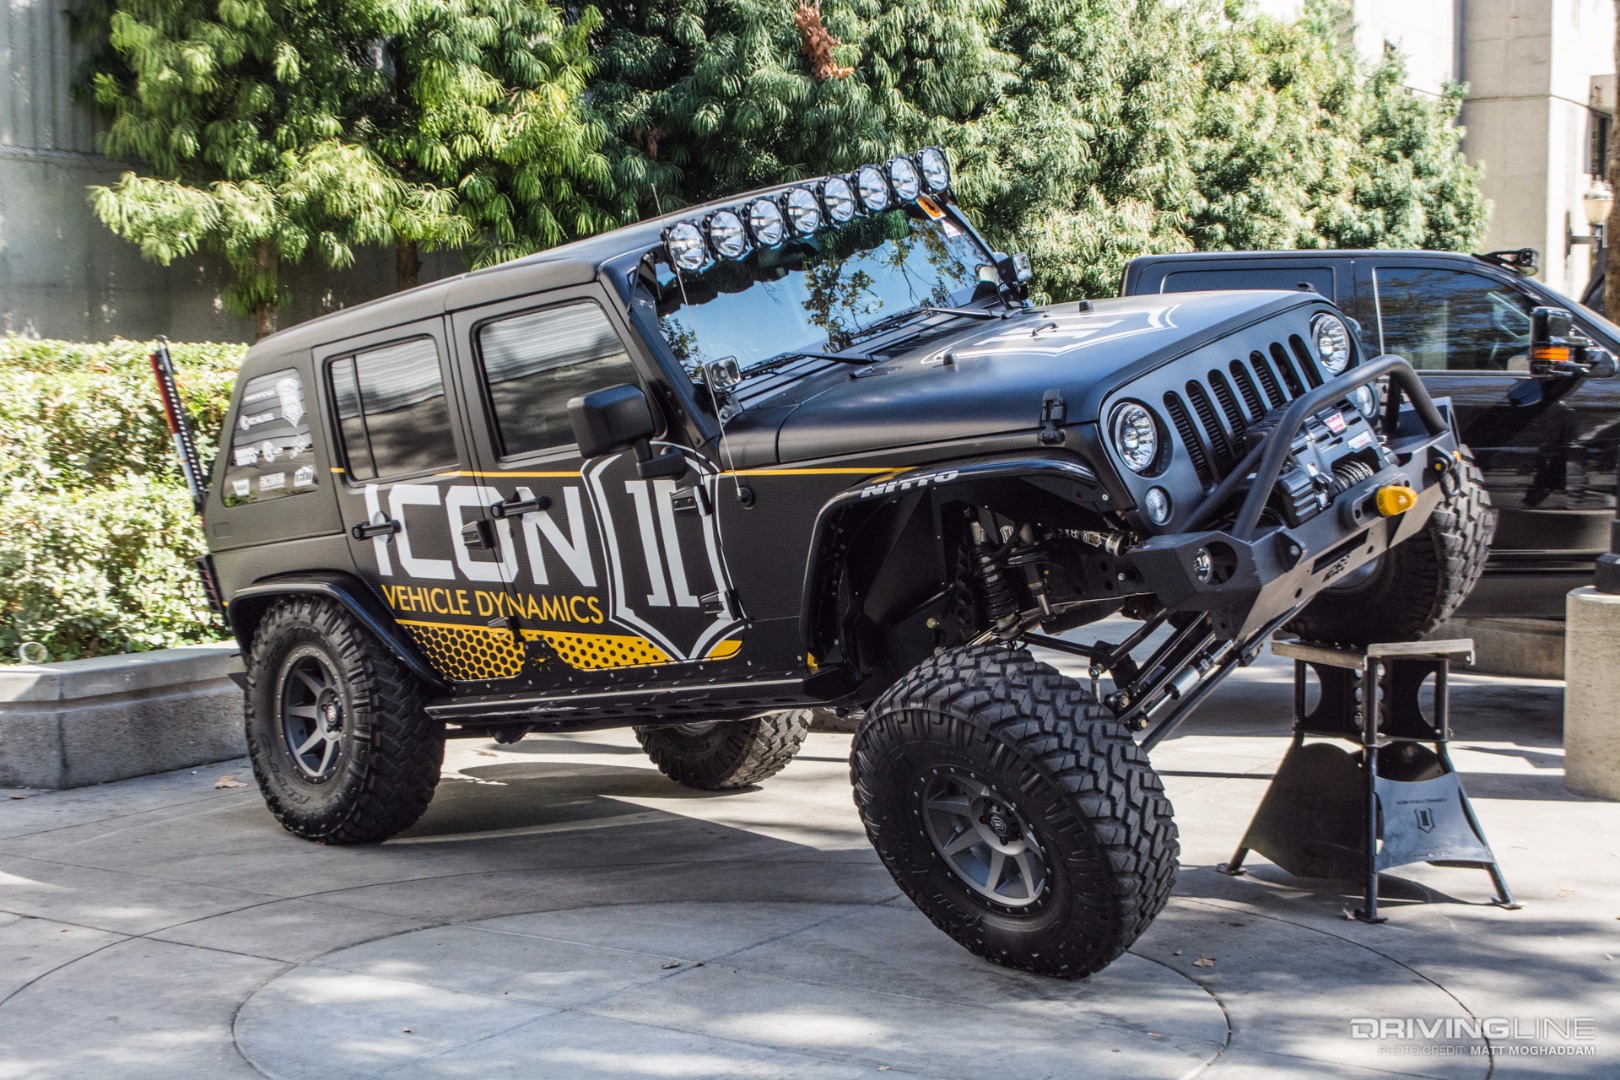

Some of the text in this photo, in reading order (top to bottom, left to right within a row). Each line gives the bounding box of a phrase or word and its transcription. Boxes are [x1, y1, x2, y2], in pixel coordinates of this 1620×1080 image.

[860, 470, 959, 499] NITTO
[364, 483, 598, 587] ICON
[381, 584, 605, 624] VEHICLE DYNAMICS
